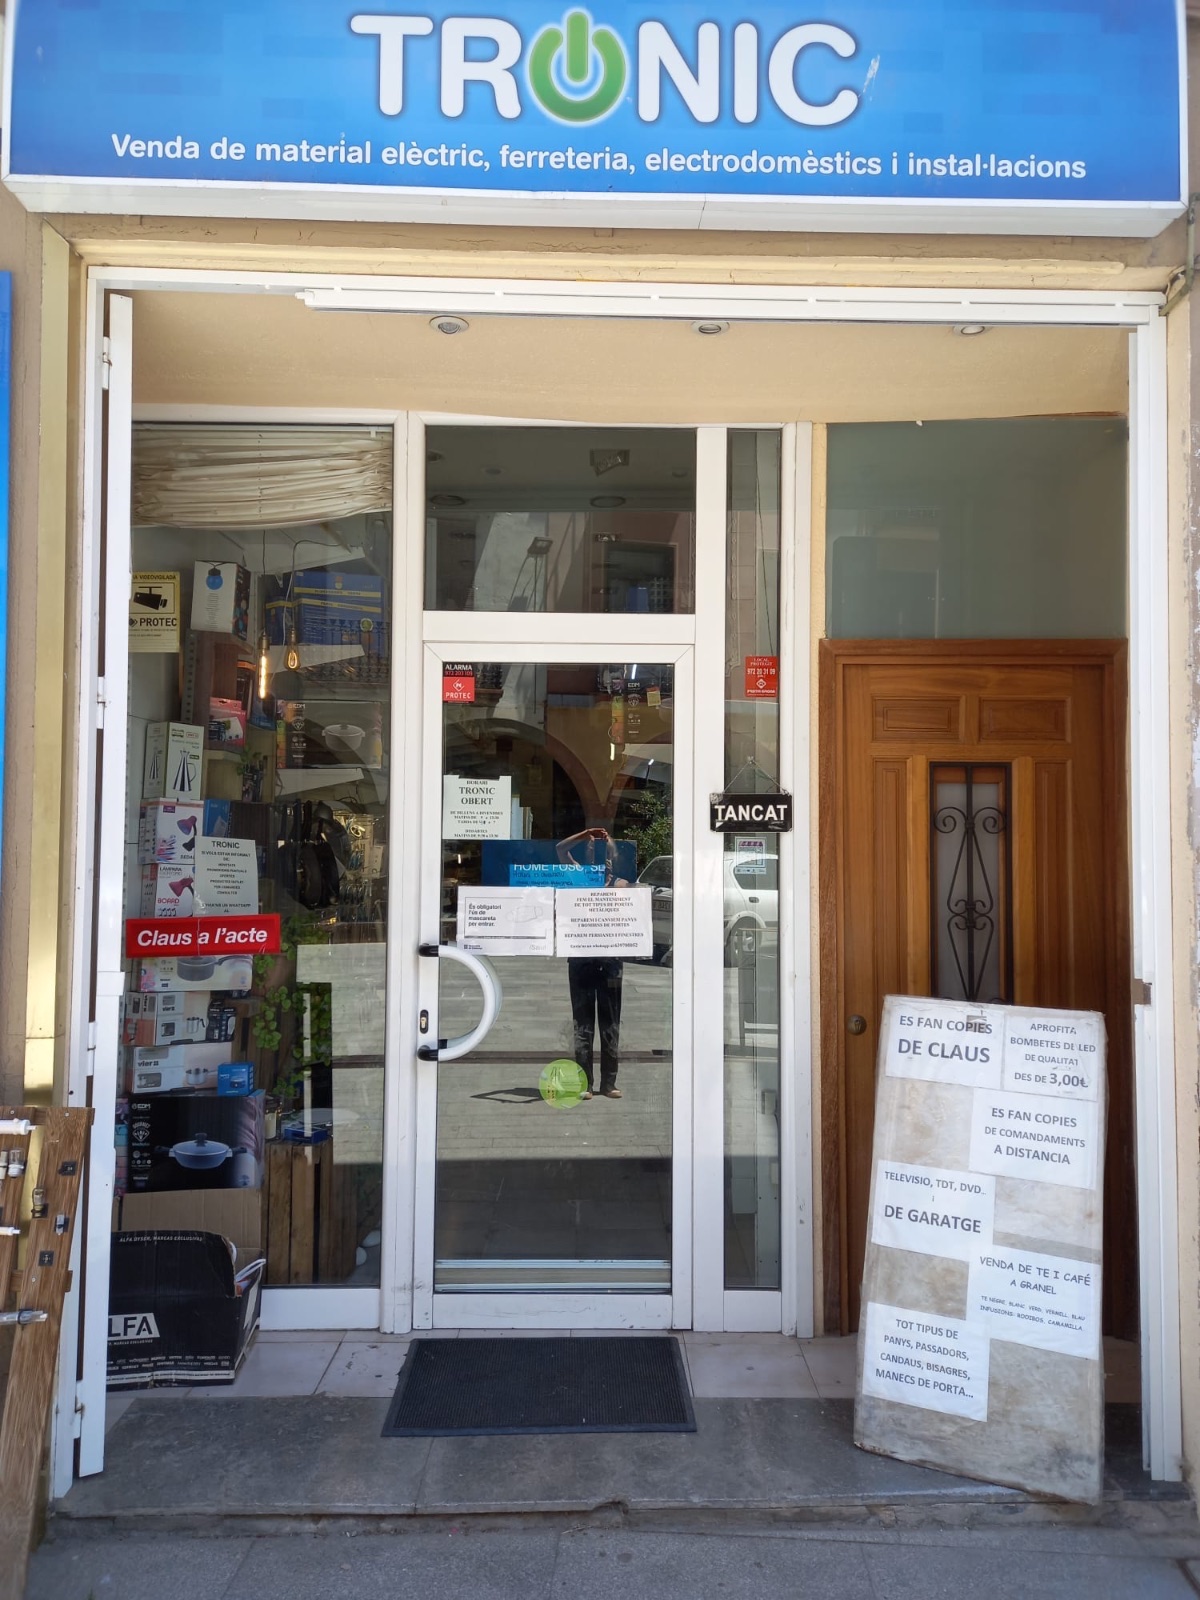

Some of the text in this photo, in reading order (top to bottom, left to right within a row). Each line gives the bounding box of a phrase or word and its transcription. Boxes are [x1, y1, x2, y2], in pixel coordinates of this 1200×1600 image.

[350, 8, 859, 127] TRONIC
[111, 133, 1087, 179] Venda de material elèctric, ferreteria, electrodomèstics i instal·lacions
[139, 617, 178, 627] PROTEC
[445, 691, 471, 699] PROTEC
[459, 786, 496, 795] TRONIC
[461, 797, 494, 805] OBERT
[714, 804, 788, 822] TANCAT
[211, 840, 240, 849] TRONIC
[468, 902, 502, 911] És obligatori
[137, 929, 192, 947] Claus
[197, 933, 210, 945] a
[899, 1015, 993, 1034] ES FAN COPIES
[1030, 1023, 1077, 1035] APROFITA
[898, 1038, 991, 1063] DE CLAUS
[1010, 1036, 1061, 1050] BOMBETES
[1078, 1043, 1096, 1053] LED
[1024, 1053, 1079, 1066] DE QUALITAT
[1014, 1072, 1089, 1088] DES DE 3,00€
[991, 1107, 1078, 1127] ES FAN COPIES
[984, 1126, 1086, 1149] DE COMANDAMENTS
[994, 1144, 1071, 1165] A DISTANCIA
[885, 1171, 934, 1188] TELEVISIO,
[936, 1179, 957, 1192] TDT,
[884, 1204, 982, 1234] DE GARATGE
[979, 1257, 1091, 1287] VENDA DE TE I CAFÉ
[1010, 1279, 1057, 1295] A GRANEL
[108, 1315, 153, 1338] LFA
[895, 1318, 959, 1340] TOT TIPUS DE
[883, 1334, 970, 1362] PANYS, PASSADORS,
[880, 1352, 971, 1381] CANDAUS, BISAGRES,
[875, 1368, 974, 1399] MANECS DE PORTA...
